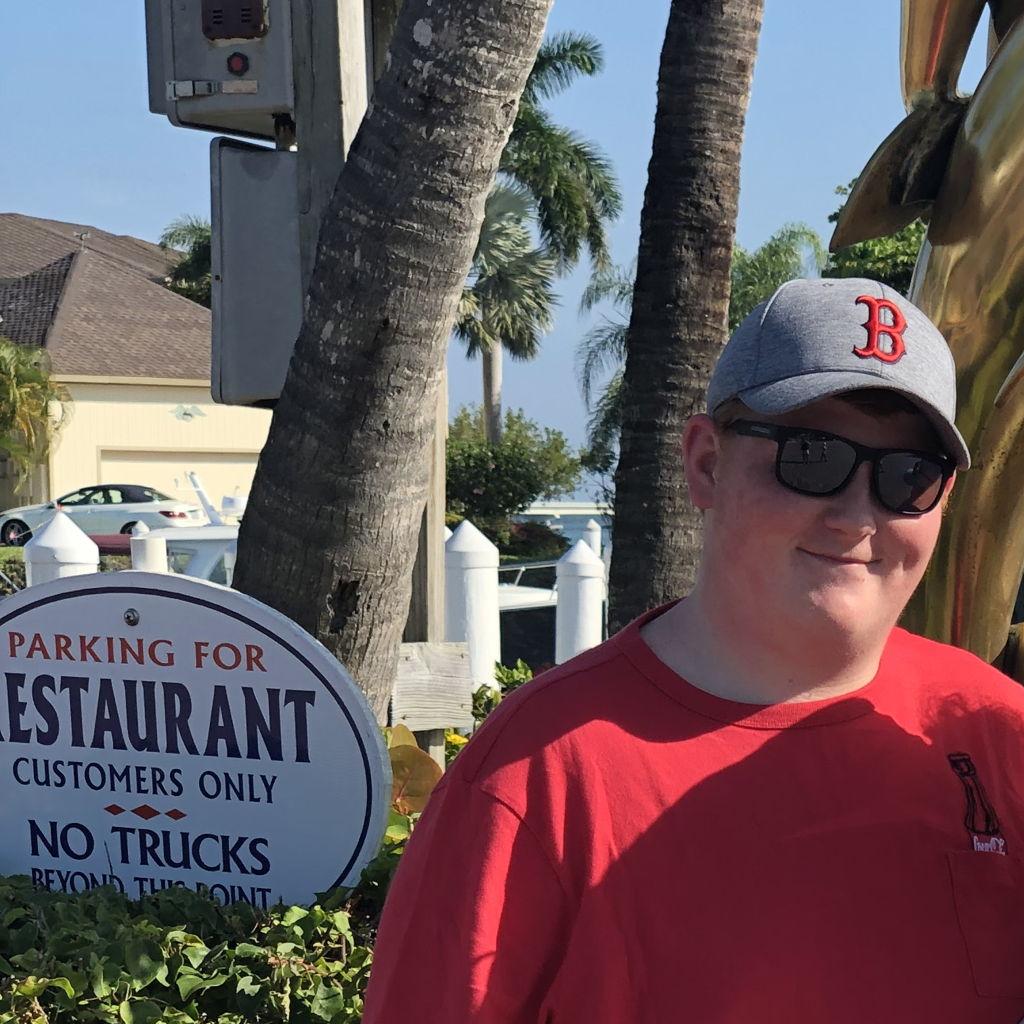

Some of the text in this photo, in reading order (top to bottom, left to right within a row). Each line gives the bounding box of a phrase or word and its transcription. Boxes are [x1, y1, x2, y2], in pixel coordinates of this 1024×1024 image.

[852, 295, 908, 364] B
[8, 632, 267, 672] PARKING FOR
[0, 671, 316, 764] ESTAURANT
[12, 757, 278, 804] CUSTOMERS ONLY
[28, 819, 271, 876] NO TRUCKS
[133, 876, 186, 900] TH
[195, 882, 272, 909] OINT
